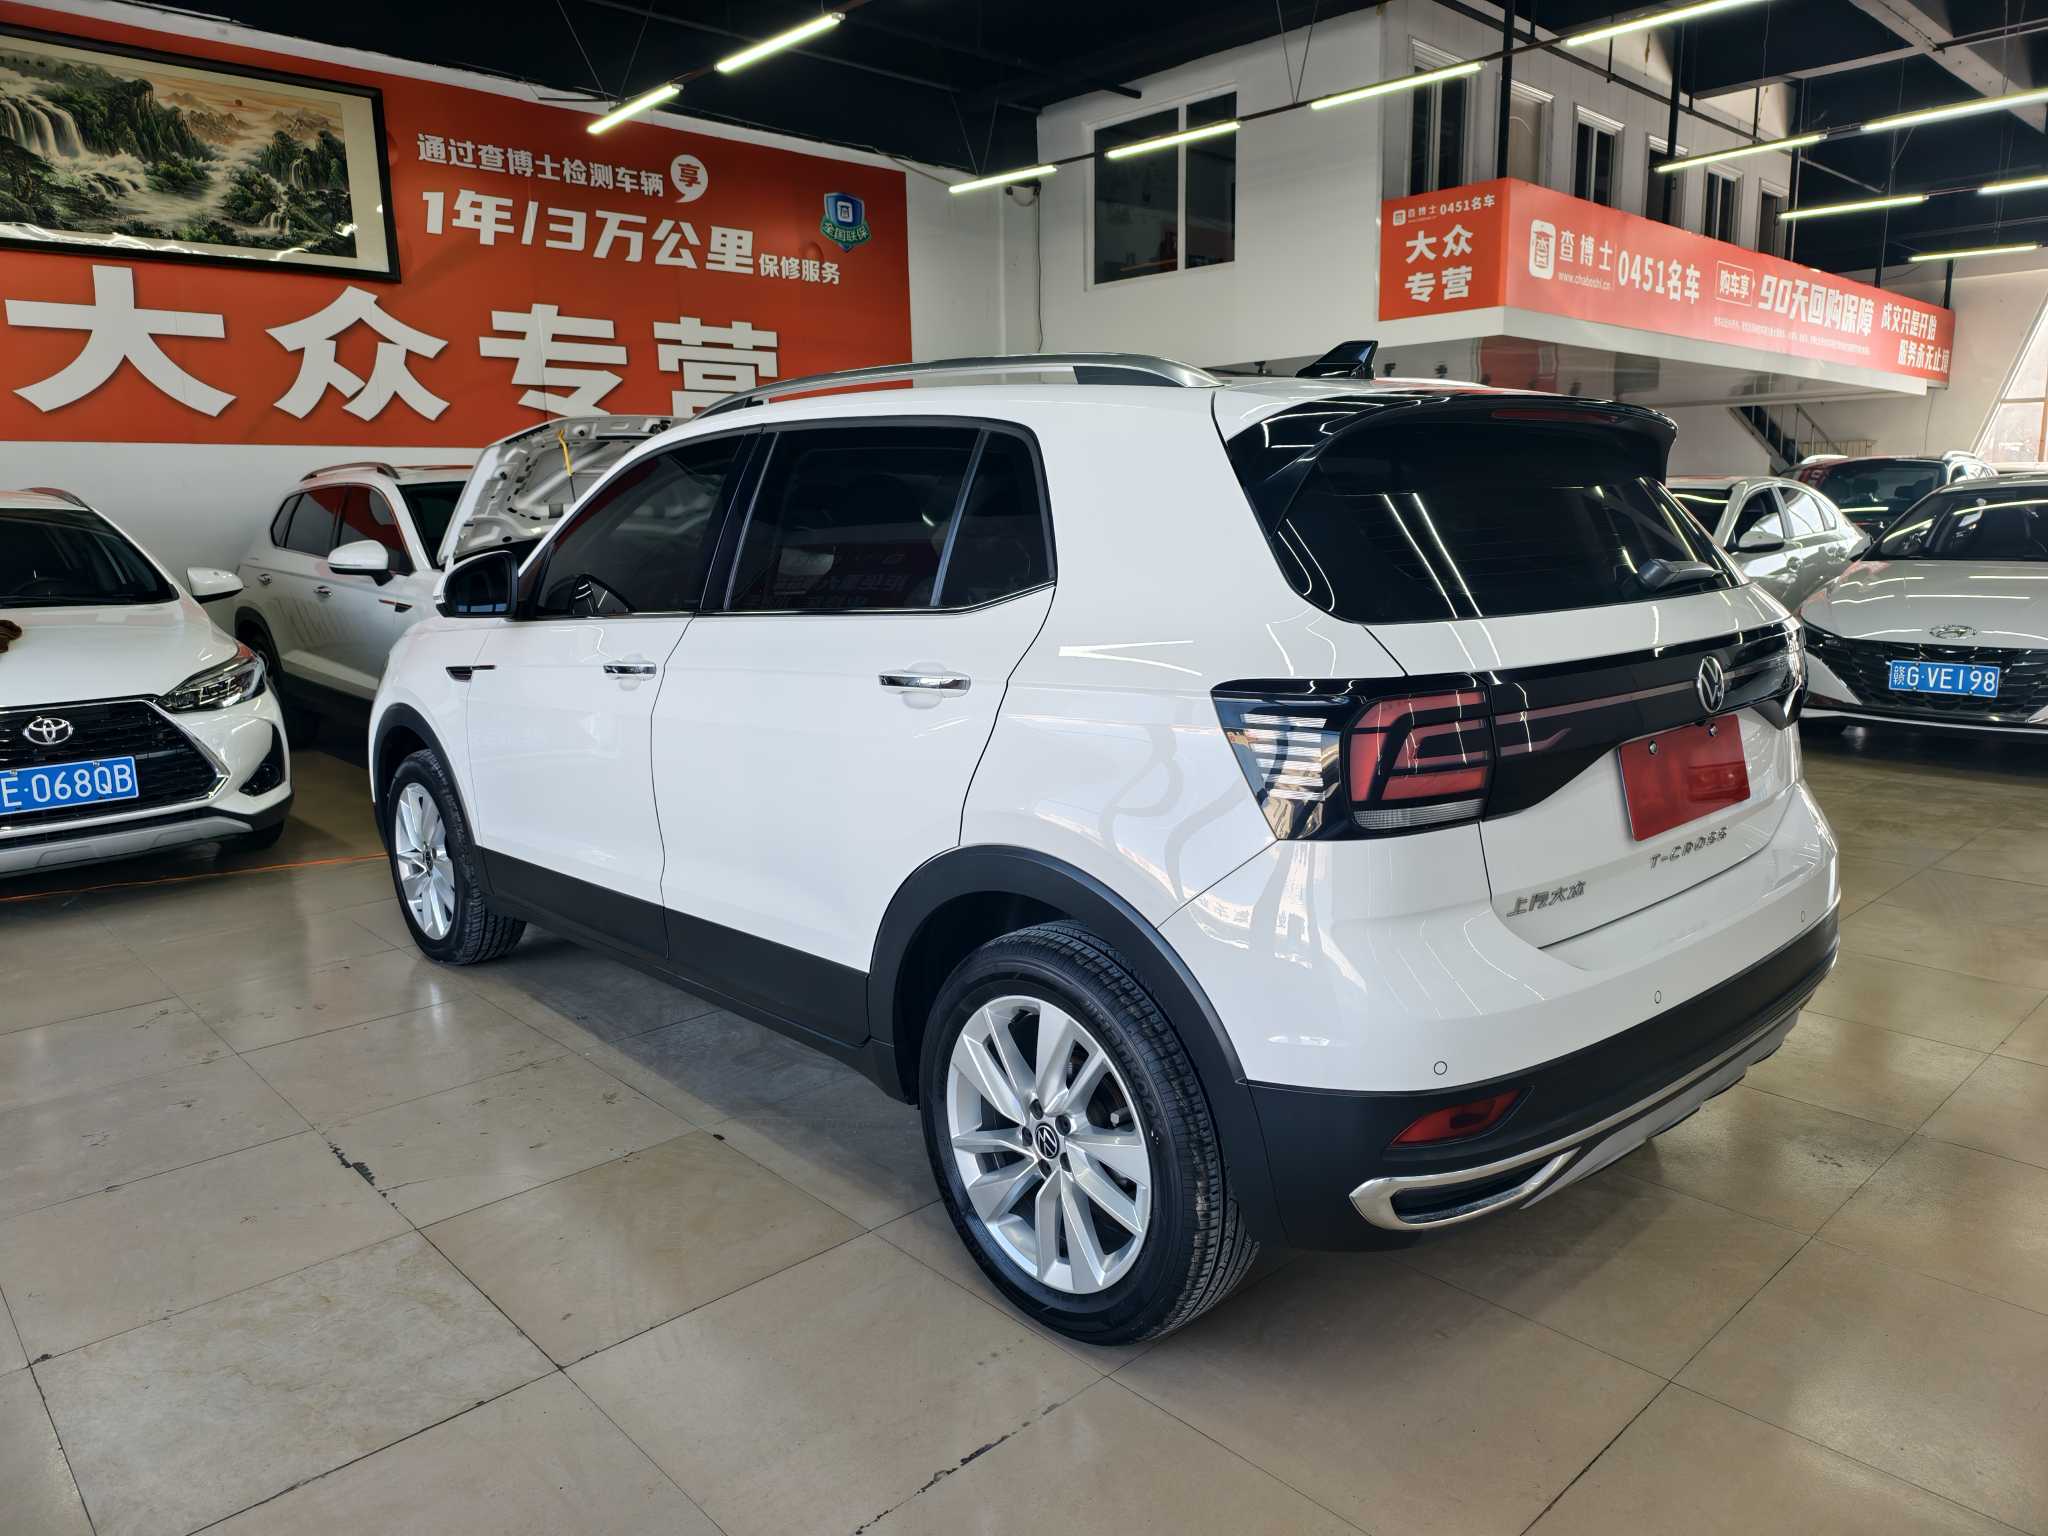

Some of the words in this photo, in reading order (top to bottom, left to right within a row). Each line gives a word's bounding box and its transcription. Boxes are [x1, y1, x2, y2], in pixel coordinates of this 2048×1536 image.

[417, 133, 664, 198] 通过查博士检测车辆
[676, 162, 703, 188] 享
[1405, 224, 1473, 264] 大众
[758, 252, 841, 285] 保修服务
[1404, 265, 1473, 303] 专营
[1559, 229, 1613, 272] 查博士
[1617, 250, 1701, 305] 0451名车
[1719, 269, 1750, 299] 购车享
[1758, 273, 1875, 337] 90天回购保障
[1881, 302, 1937, 341] 成交只是开始
[5, 265, 779, 422] 大众专营
[1650, 826, 1728, 871] T-CROSS
